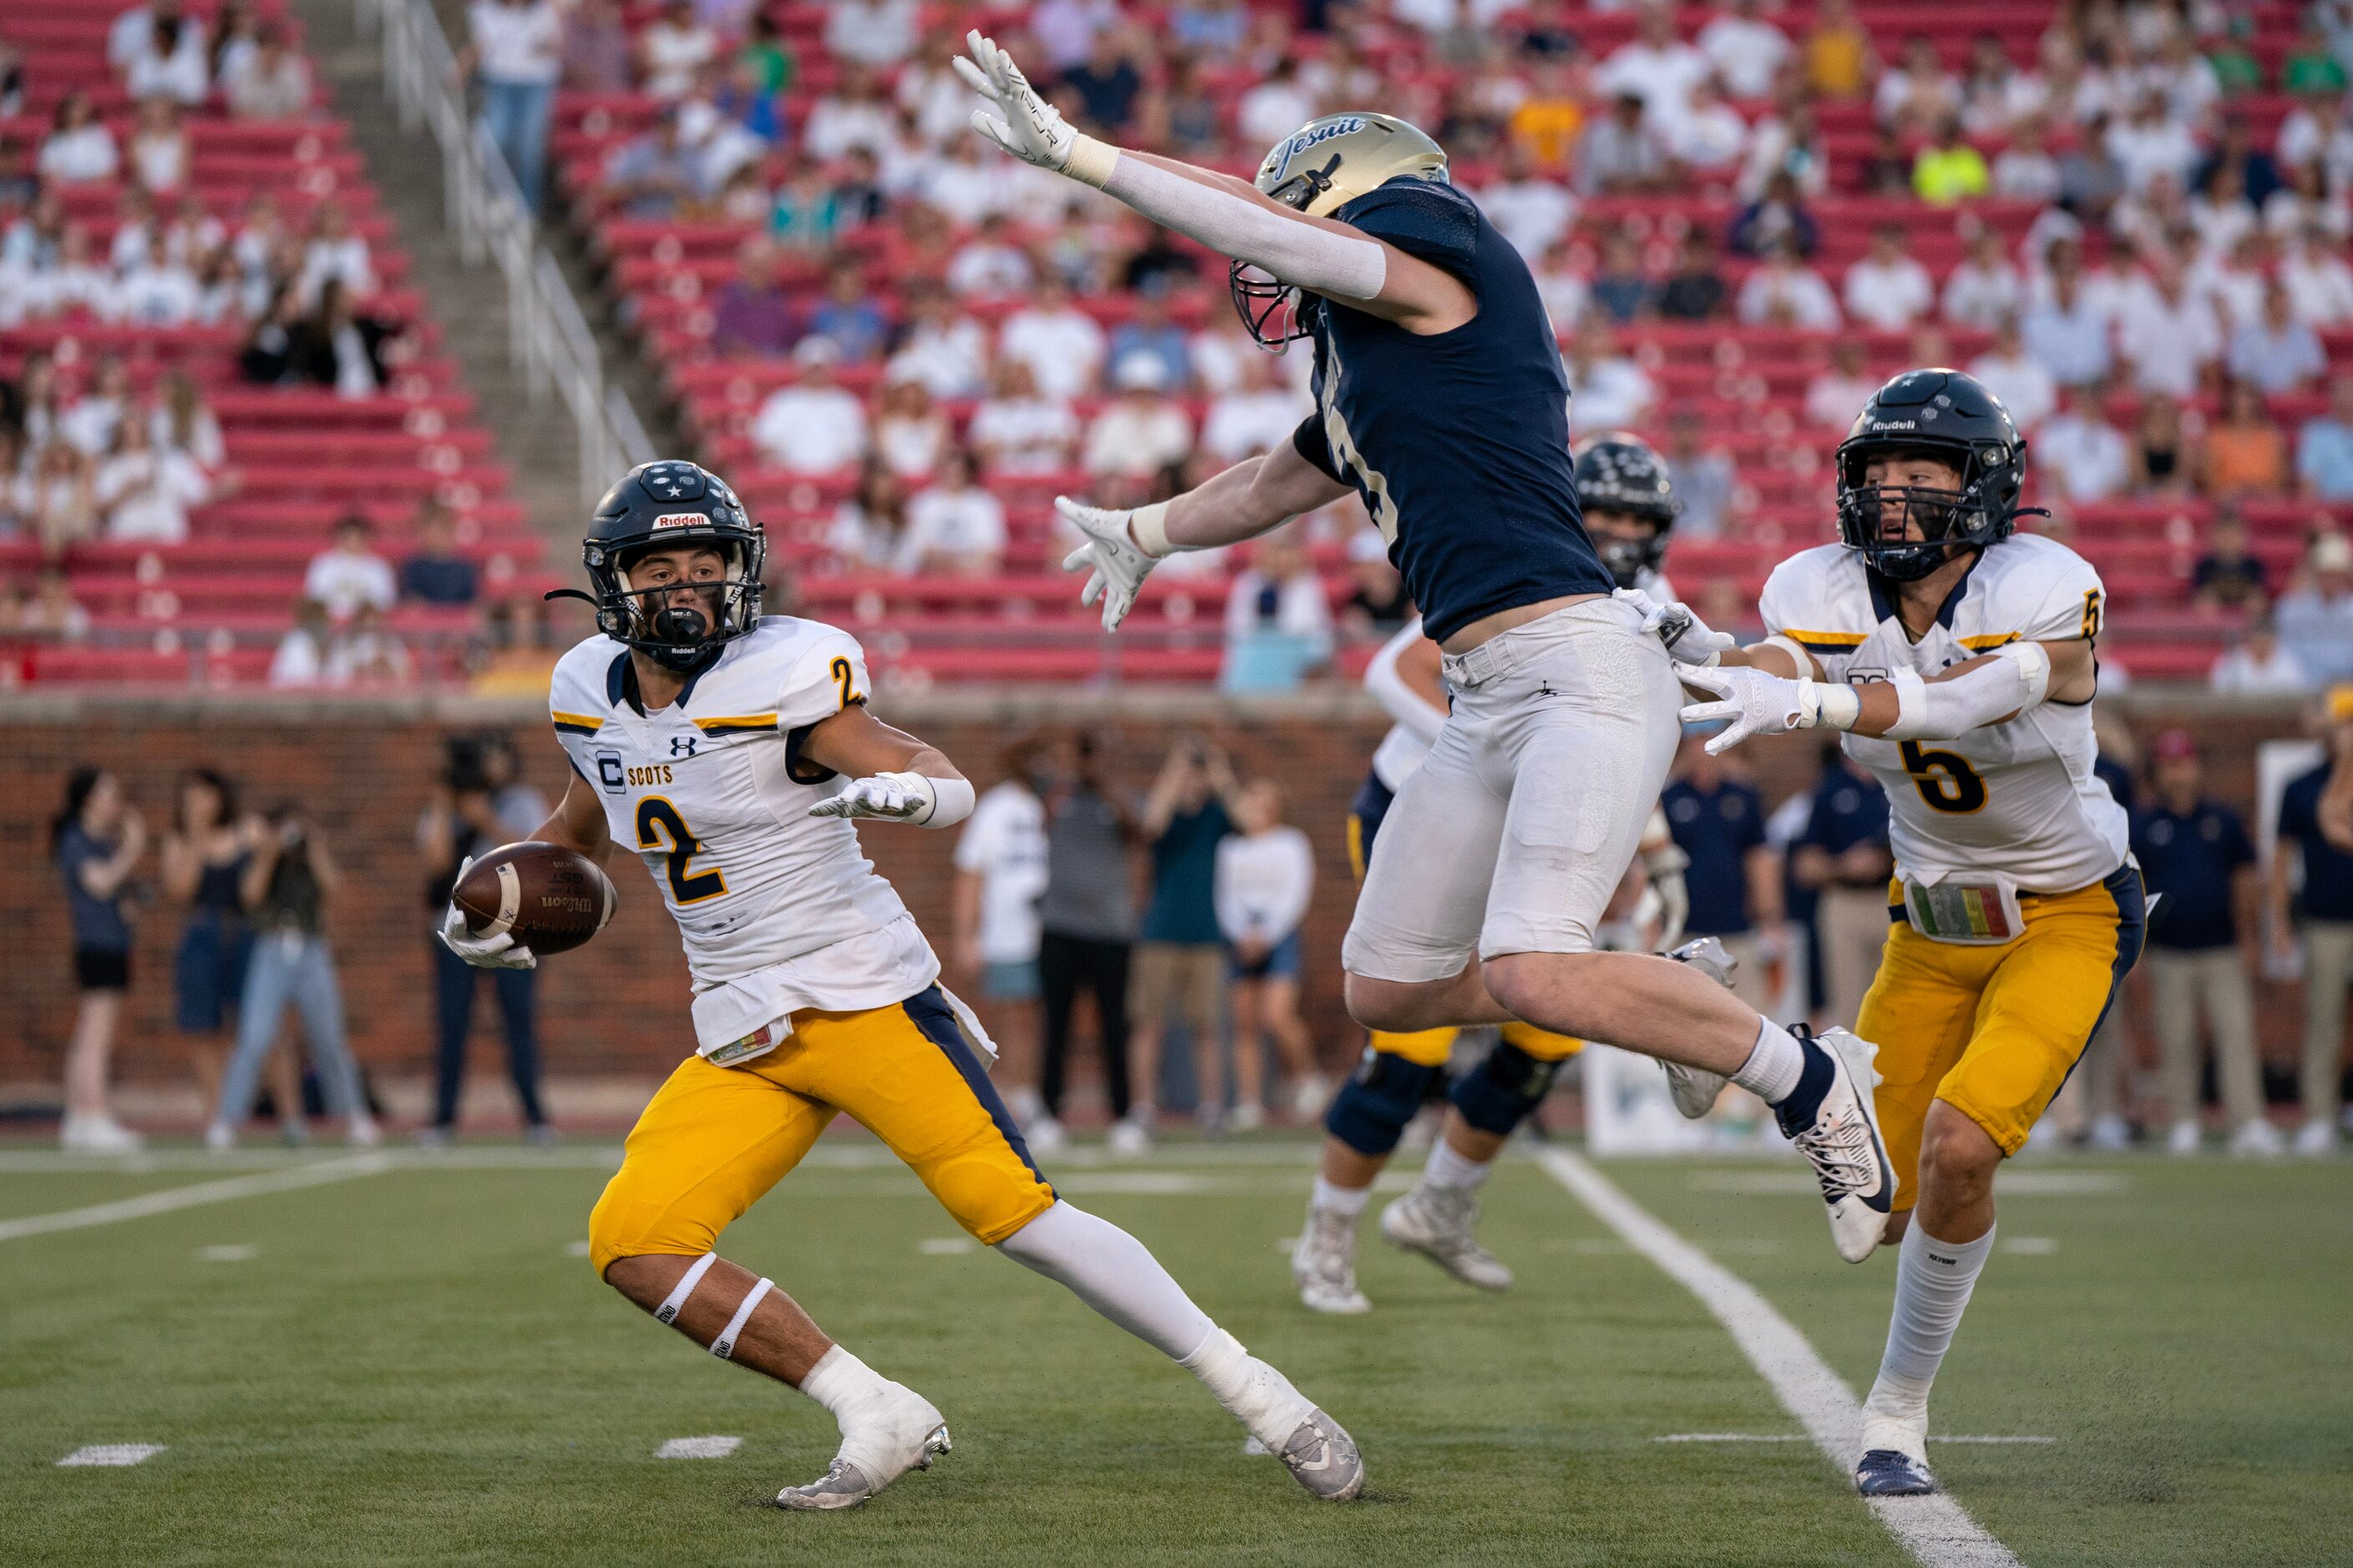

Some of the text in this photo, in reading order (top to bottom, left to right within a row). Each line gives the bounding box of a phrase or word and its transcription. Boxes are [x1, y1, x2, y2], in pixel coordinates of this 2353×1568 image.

[1273, 117, 1366, 182] Jesuit
[1872, 420, 1915, 431] Riddell
[660, 516, 705, 527] Riddell
[2081, 587, 2101, 640] 5
[829, 655, 863, 710] 2
[628, 765, 673, 787] SCOTS
[1897, 740, 1989, 816] 5
[635, 794, 731, 906] 2
[541, 896, 593, 913] Wilson
